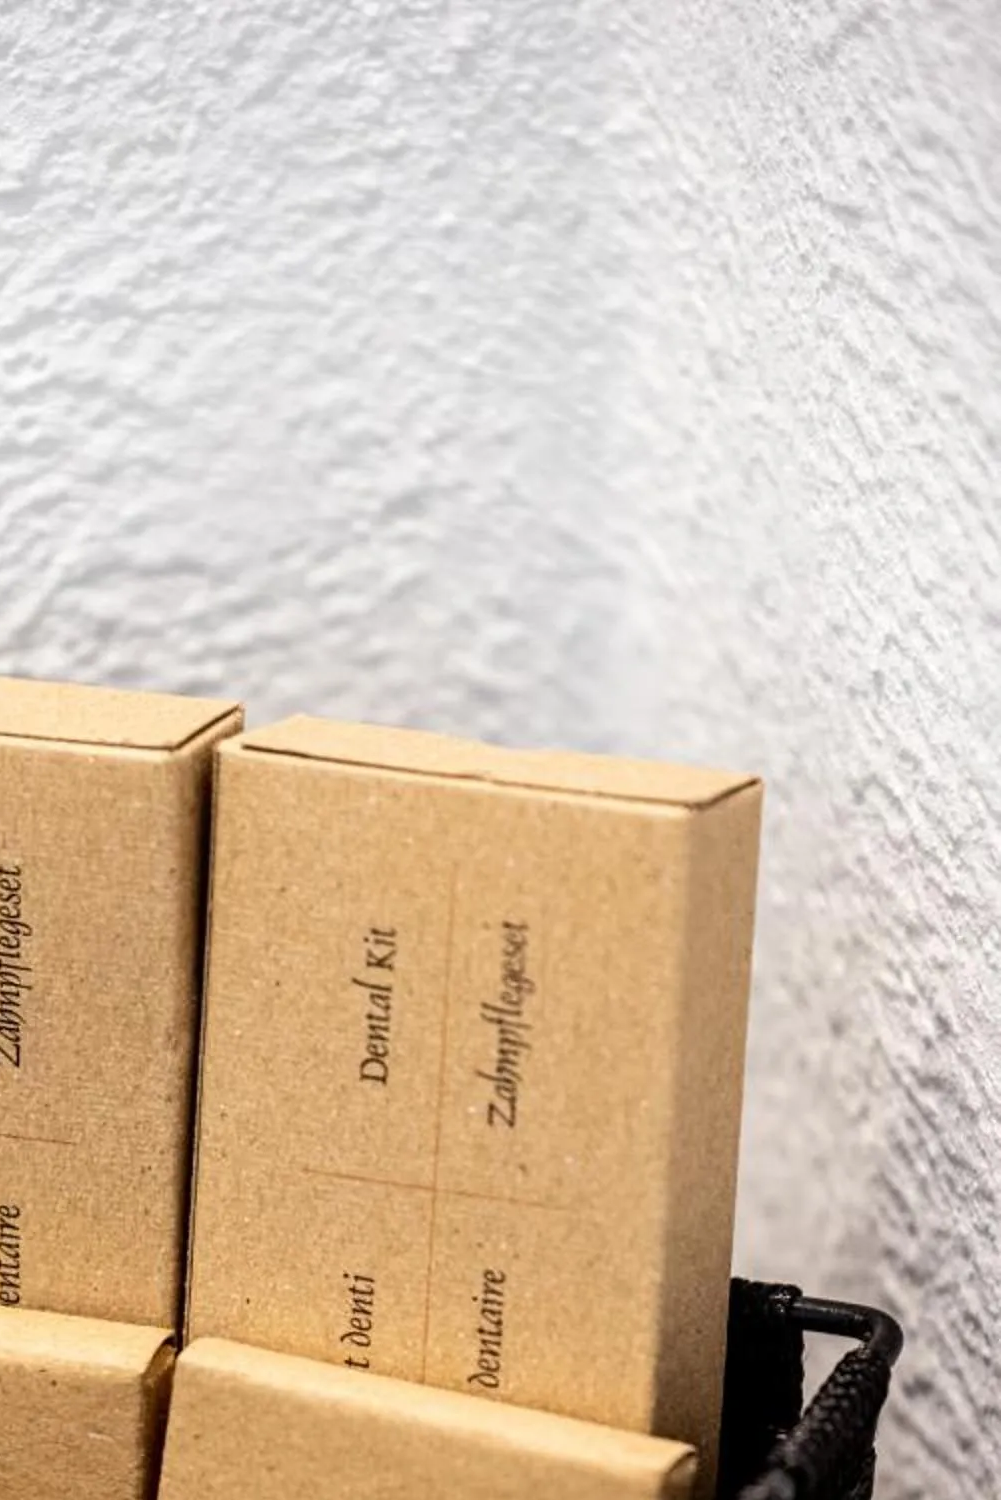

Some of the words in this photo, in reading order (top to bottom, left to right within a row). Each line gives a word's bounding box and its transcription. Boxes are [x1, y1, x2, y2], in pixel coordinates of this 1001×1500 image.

[362, 927, 398, 972] Kit
[351, 977, 393, 1086] Dental
[340, 1272, 376, 1348] denti
[466, 1268, 507, 1389] dentaire
